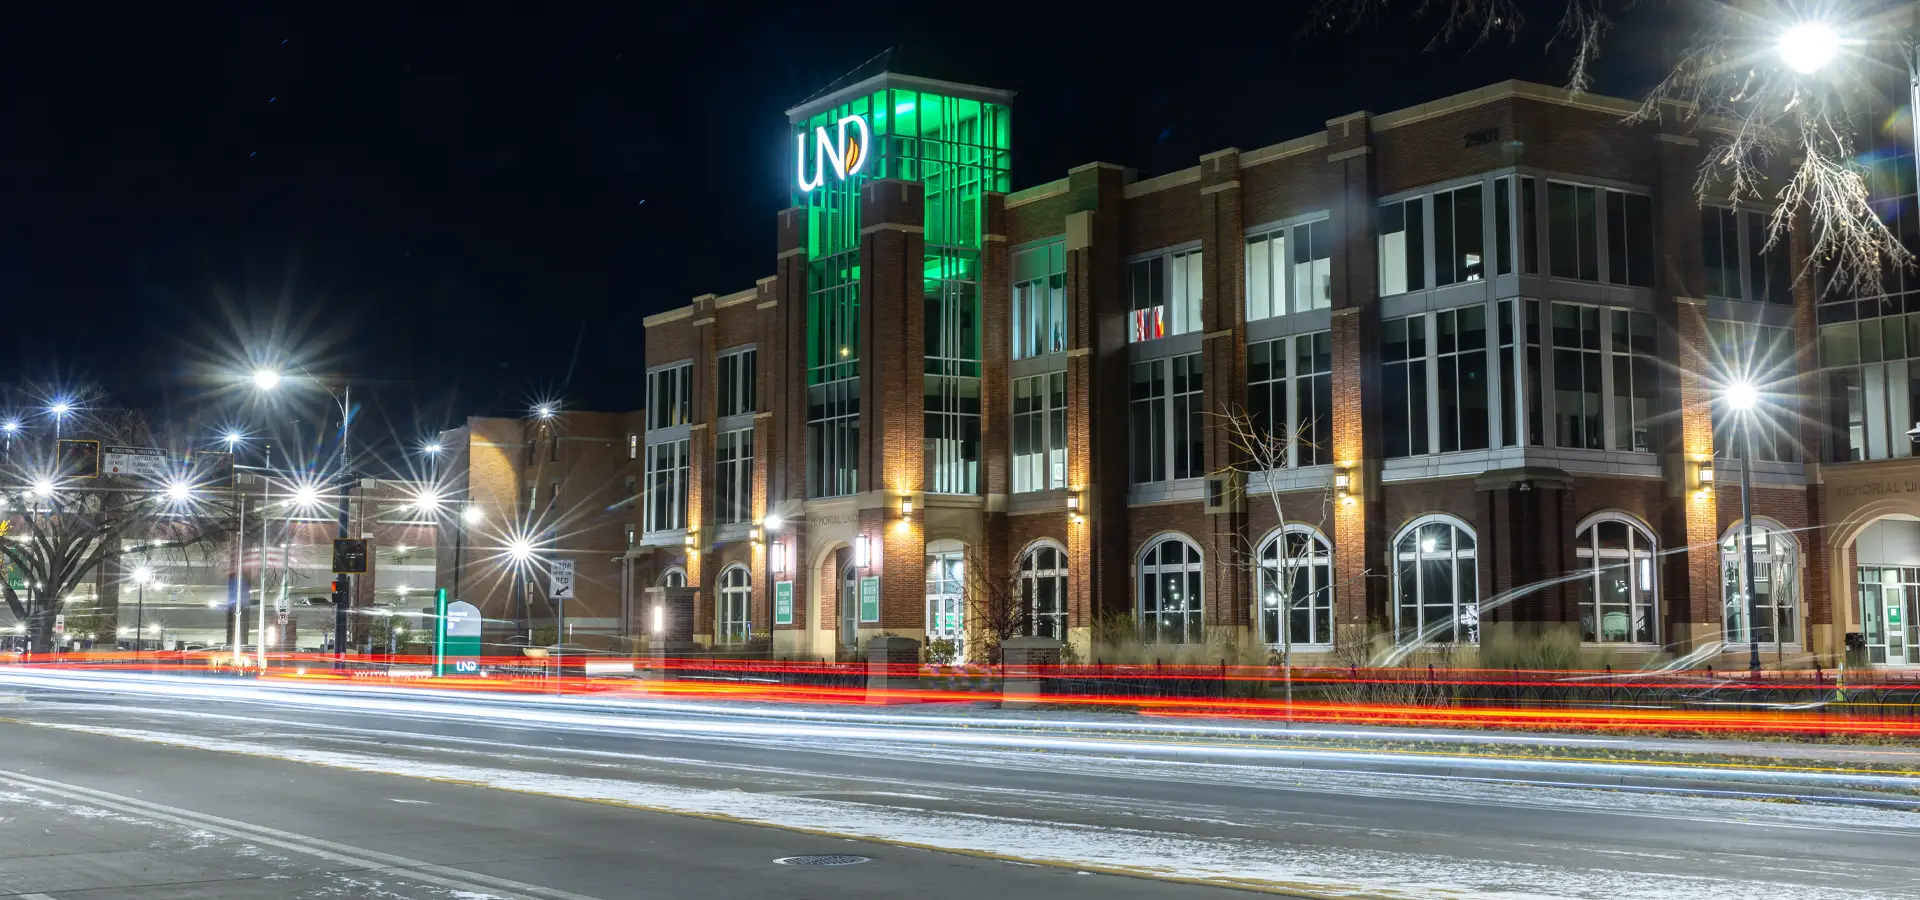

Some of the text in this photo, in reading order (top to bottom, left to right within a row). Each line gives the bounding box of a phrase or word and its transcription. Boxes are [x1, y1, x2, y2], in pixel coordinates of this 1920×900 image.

[797, 114, 868, 191] UND
[1837, 480, 1901, 497] MEMORIAL
[810, 514, 841, 527] MEMORIAL
[457, 661, 476, 671] UND
